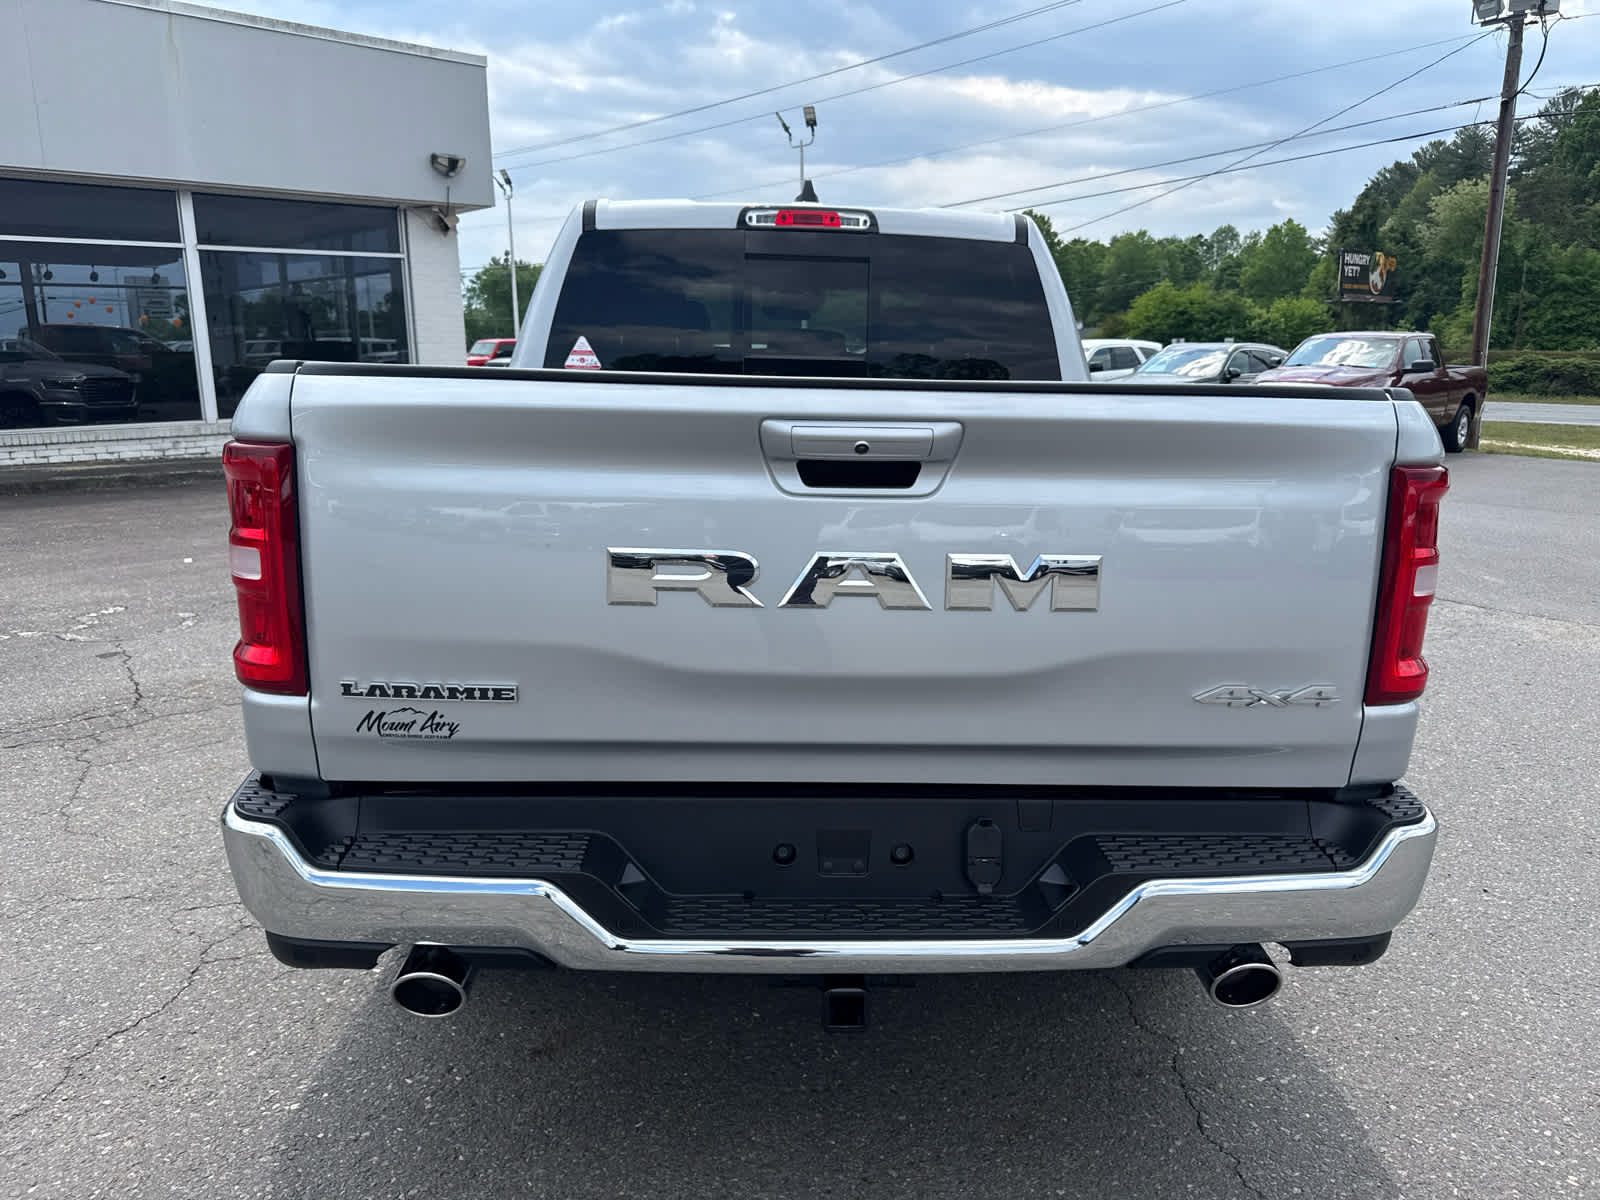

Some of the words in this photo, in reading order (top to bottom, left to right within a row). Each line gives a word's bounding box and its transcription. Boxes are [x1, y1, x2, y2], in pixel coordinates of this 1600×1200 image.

[1344, 252, 1370, 265] HUNGRY
[1344, 265, 1360, 277] YET?
[606, 546, 1103, 612] RAM
[340, 680, 519, 702] LARAMIE
[356, 709, 417, 737] Mount
[419, 709, 460, 739] Airy
